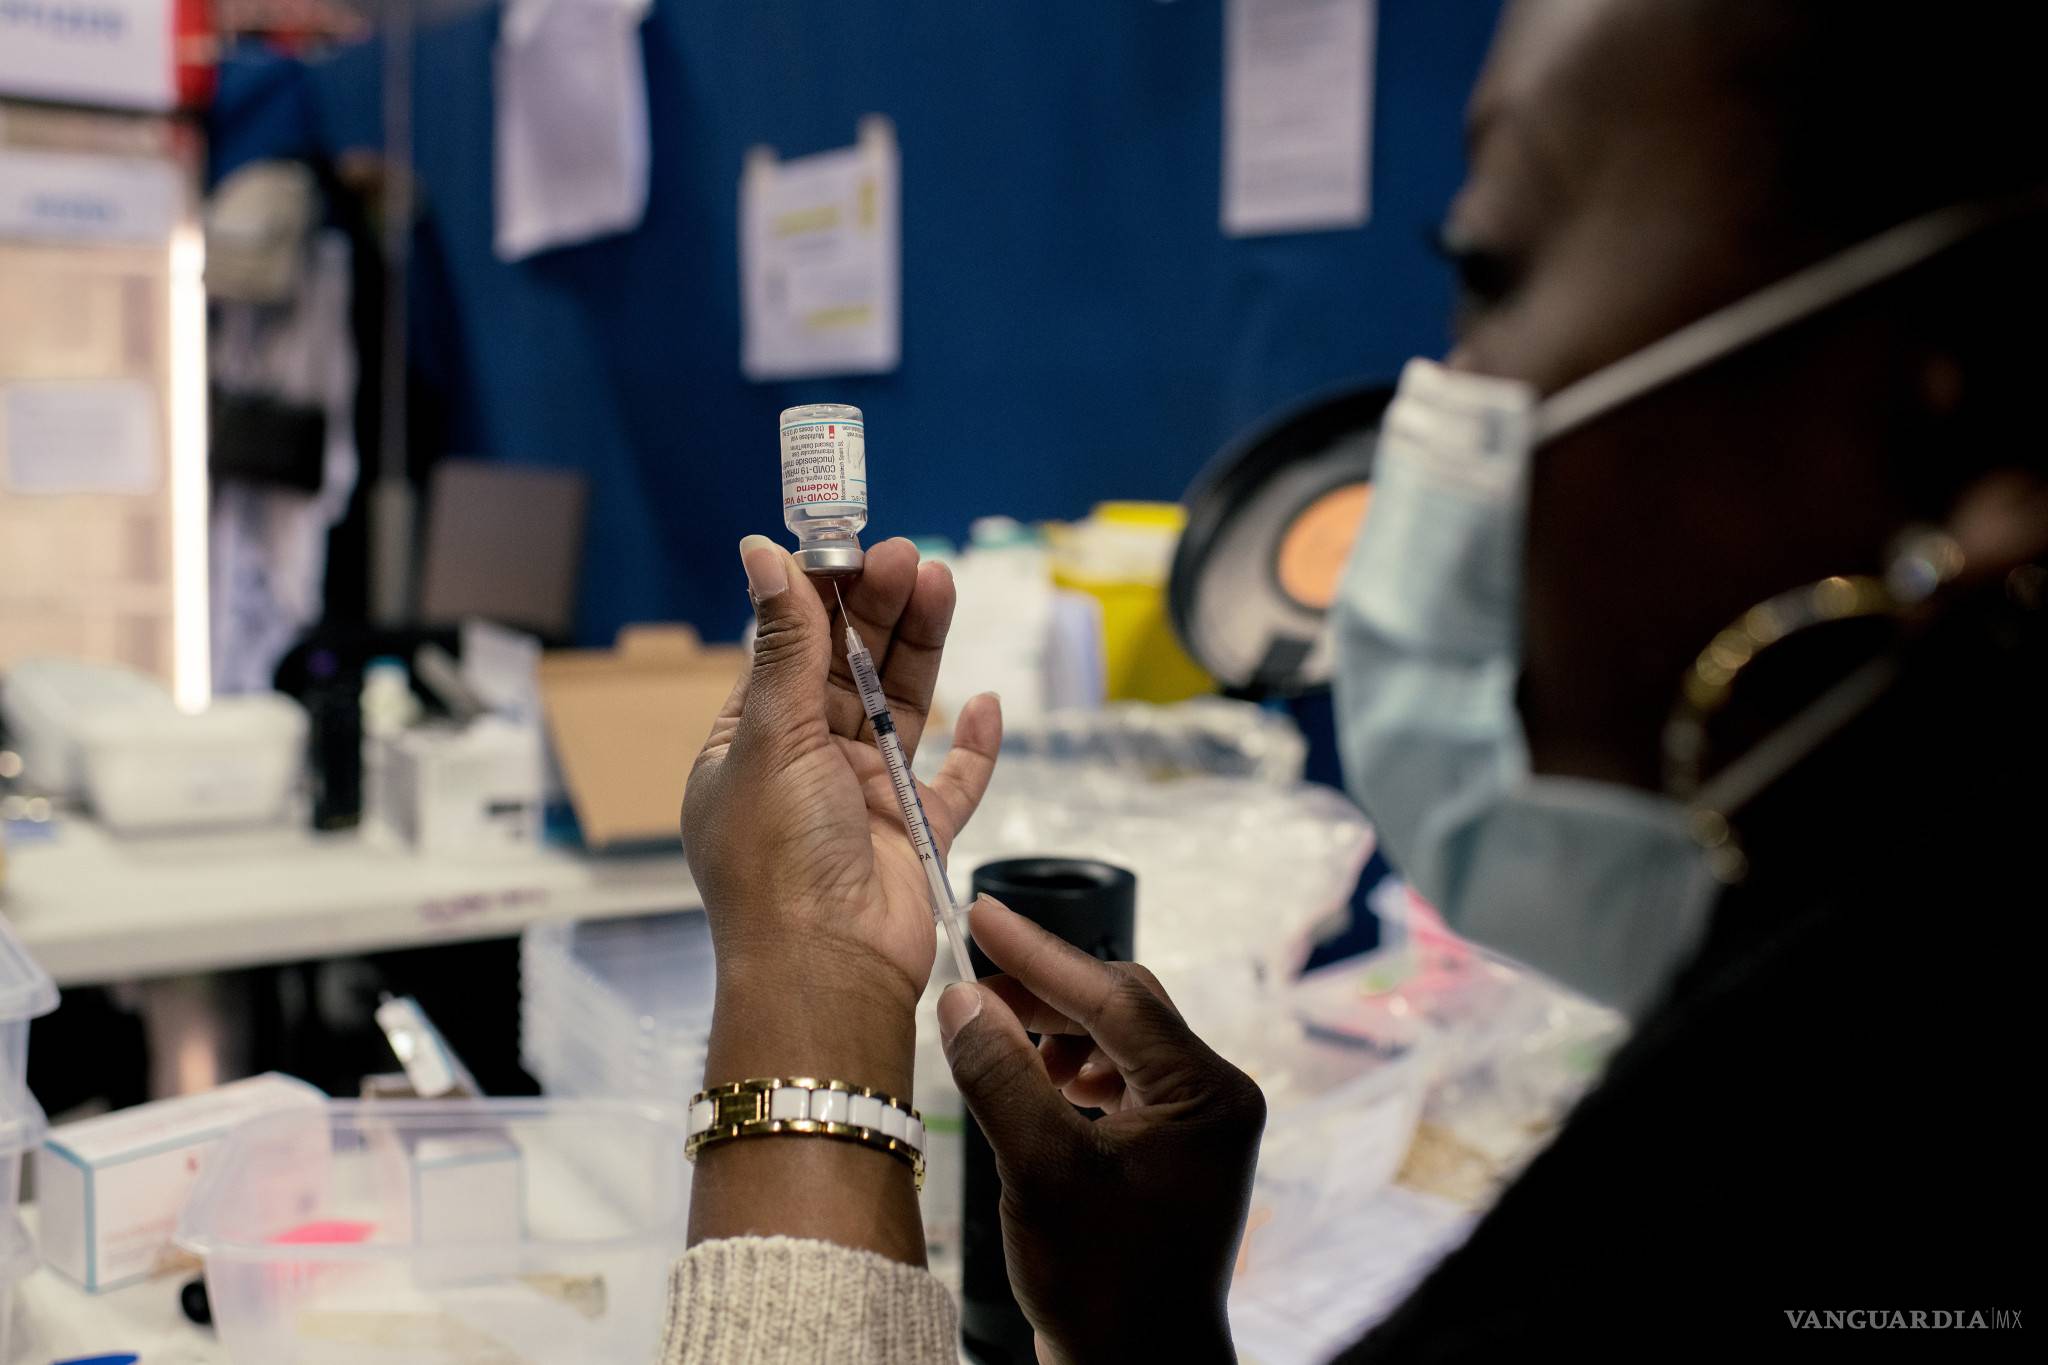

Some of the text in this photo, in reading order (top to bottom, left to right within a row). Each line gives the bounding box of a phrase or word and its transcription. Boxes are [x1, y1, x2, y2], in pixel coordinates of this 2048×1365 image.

[798, 433, 825, 441] Multidose
[800, 448, 835, 456] Intramuscular
[795, 455, 835, 465] (nucleoside
[800, 464, 836, 475] COVID-19
[796, 483, 838, 493] Moderna
[838, 479, 846, 500] Moderna
[796, 492, 839, 503] COVID-19
